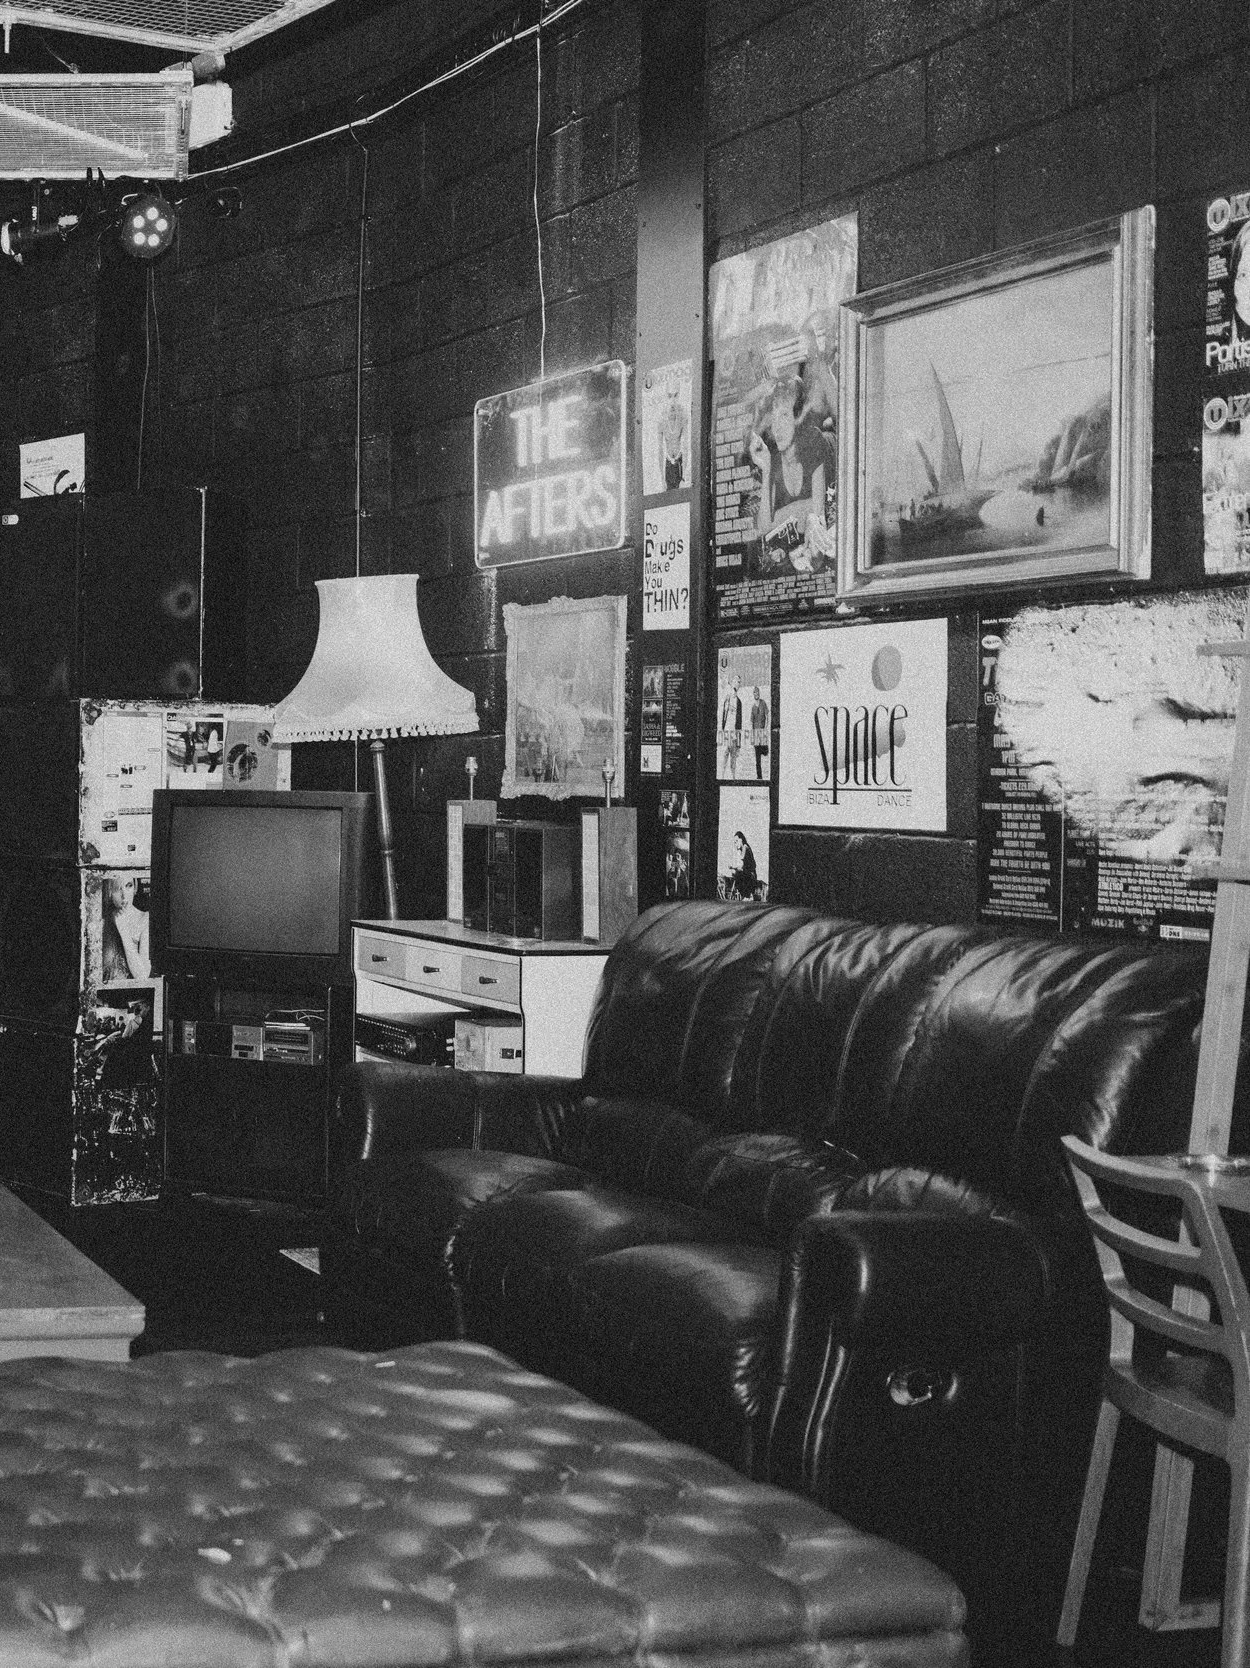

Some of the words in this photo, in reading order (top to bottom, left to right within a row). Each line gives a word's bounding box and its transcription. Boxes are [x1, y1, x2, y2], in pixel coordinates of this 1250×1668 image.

[510, 394, 583, 468] THE
[480, 464, 620, 548] AFTERS
[645, 523, 658, 536] Do
[645, 538, 684, 560] Drugs
[644, 560, 671, 575] Make
[645, 576, 663, 590] You
[644, 588, 689, 613] THIN?
[814, 704, 908, 805] space
[807, 793, 830, 806] IBIZA
[877, 795, 912, 807] DANCE
[1091, 918, 1125, 928] MUZIK
